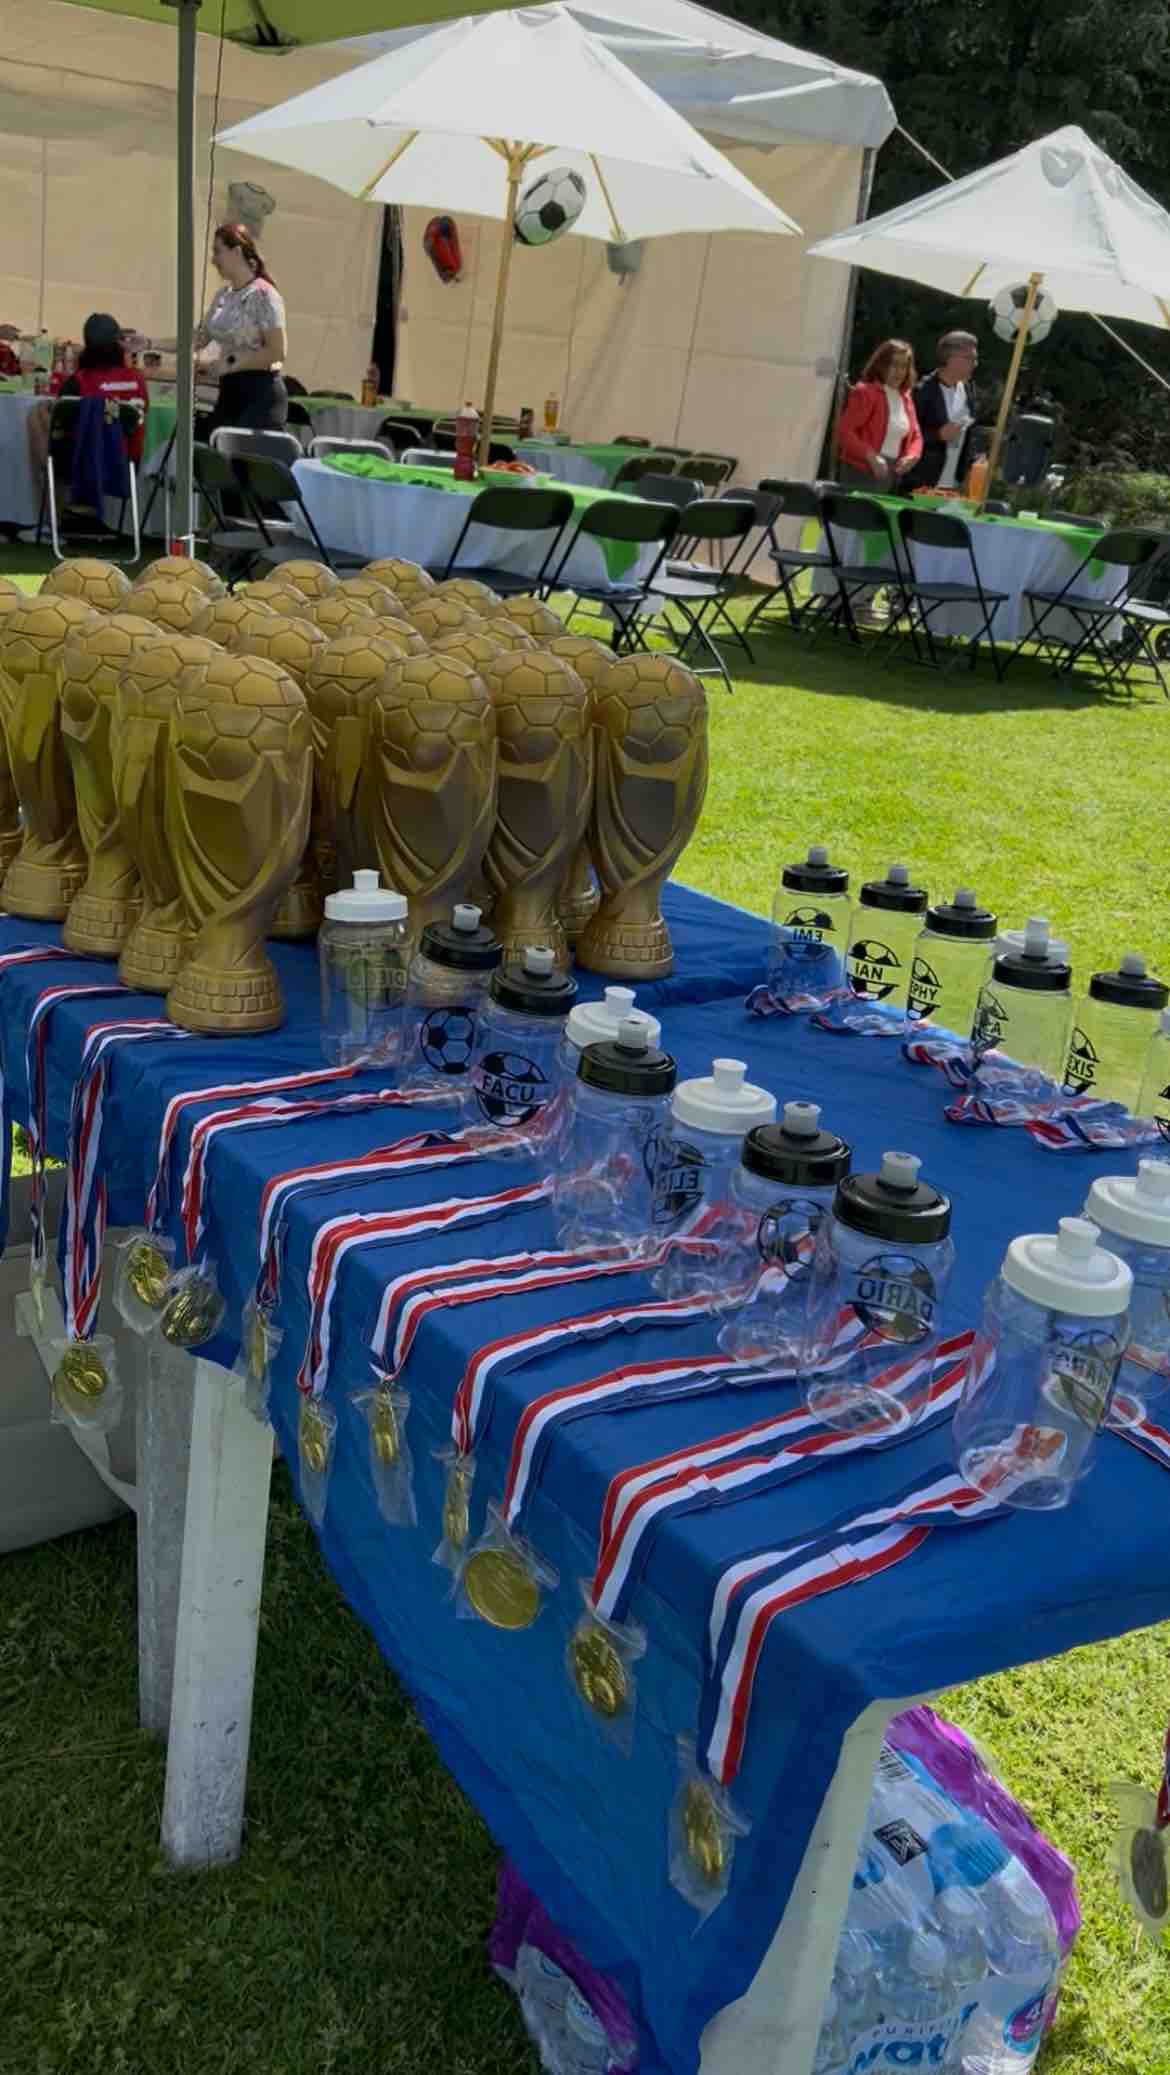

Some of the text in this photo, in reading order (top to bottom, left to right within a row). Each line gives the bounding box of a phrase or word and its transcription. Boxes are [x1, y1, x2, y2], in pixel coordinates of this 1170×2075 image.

[855, 962, 884, 980] IAN
[911, 982, 938, 1001] PHY
[482, 1075, 535, 1102] FACU
